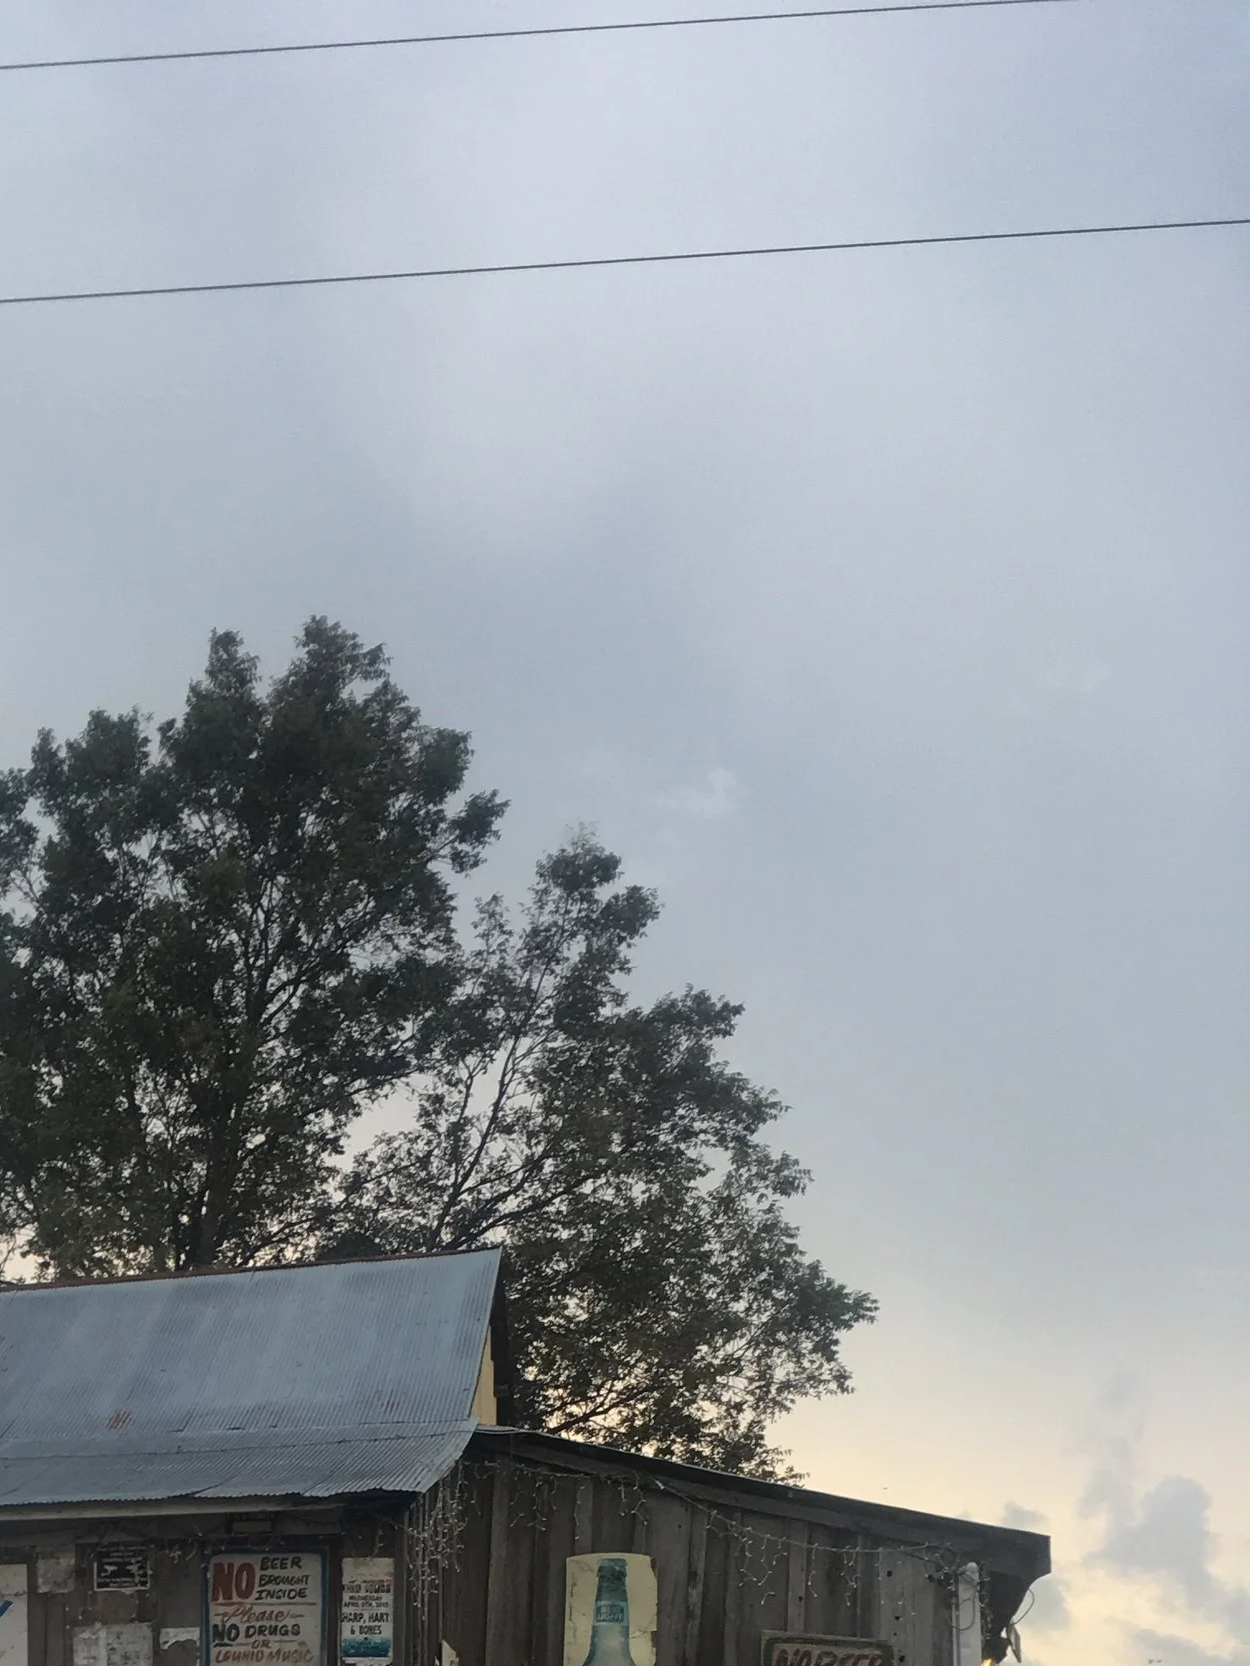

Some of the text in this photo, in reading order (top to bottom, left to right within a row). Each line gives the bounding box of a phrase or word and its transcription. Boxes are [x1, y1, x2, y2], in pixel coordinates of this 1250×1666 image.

[260, 1556, 302, 1571] BEER
[212, 1562, 256, 1602] NO
[258, 1574, 310, 1588] BROUGHT
[255, 1588, 308, 1600] INSIDE
[222, 1605, 290, 1623] Please
[212, 1623, 301, 1642] NO DRUGS
[251, 1639, 271, 1649] OR
[266, 1648, 314, 1663] MUSIC
